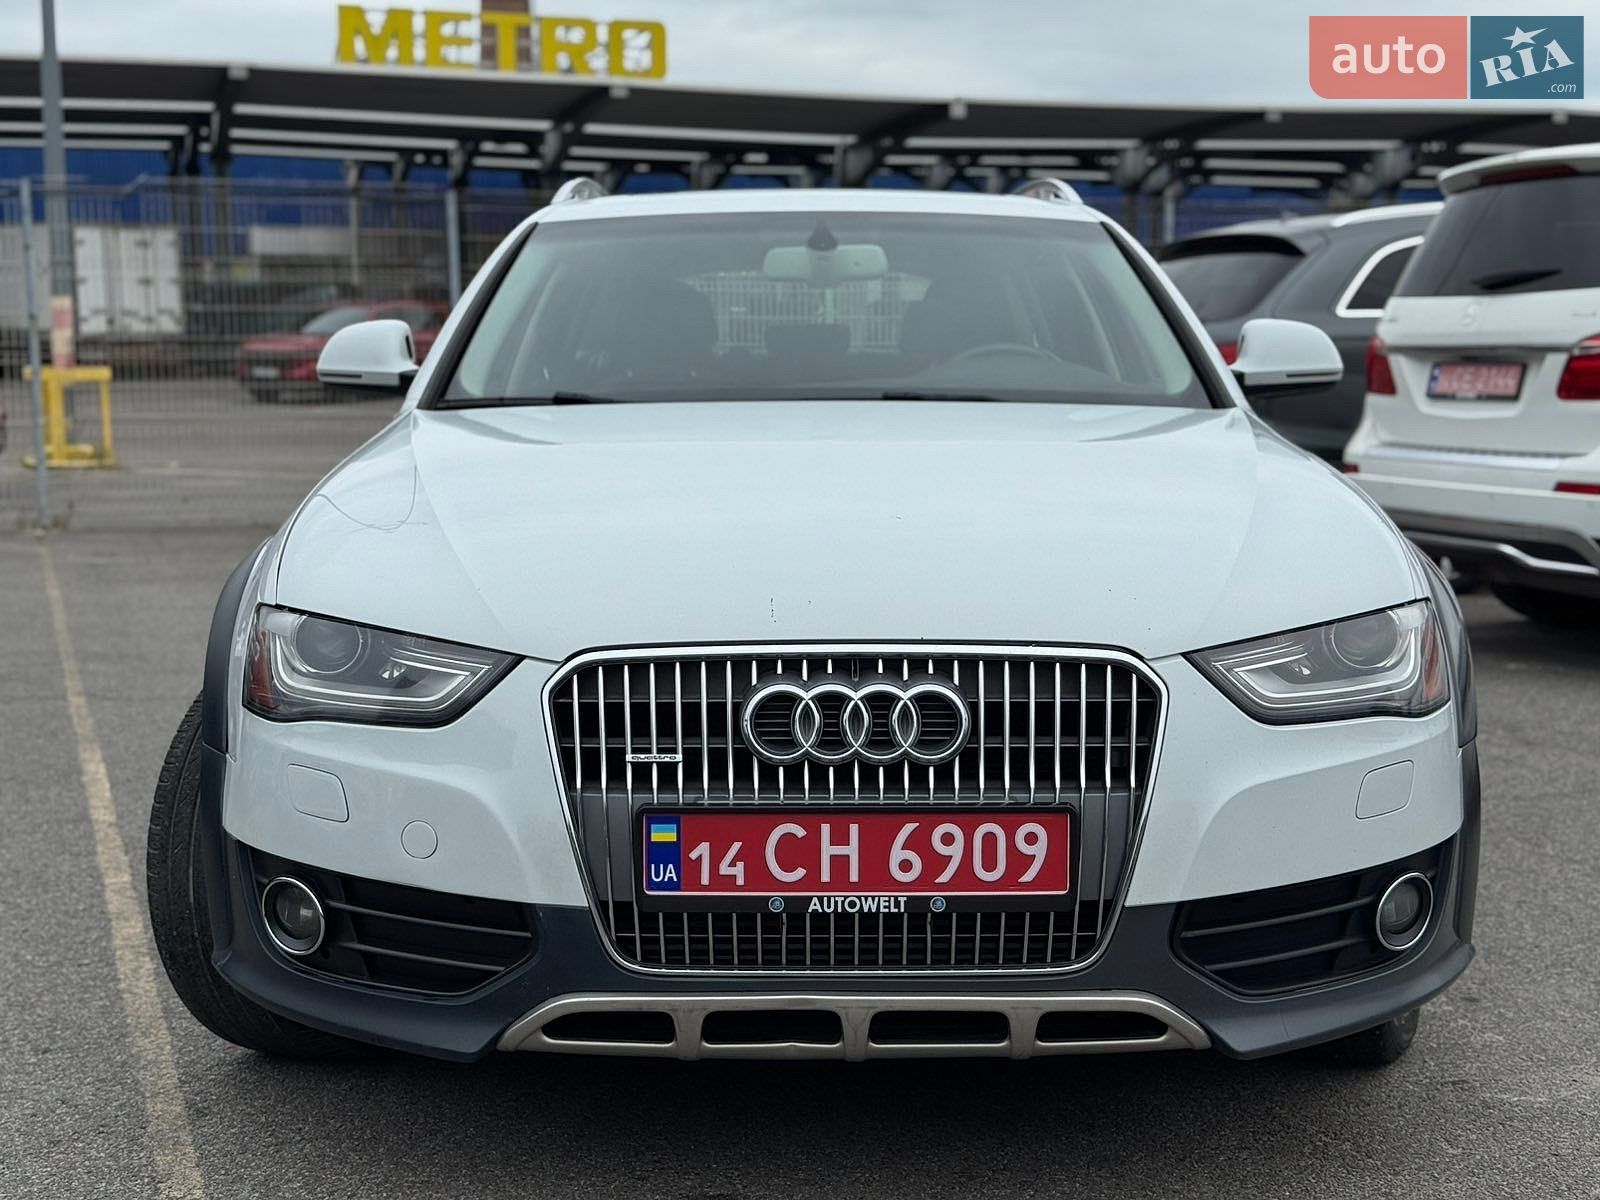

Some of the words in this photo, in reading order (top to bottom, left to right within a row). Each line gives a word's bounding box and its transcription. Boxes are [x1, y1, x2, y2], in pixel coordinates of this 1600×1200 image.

[337, 5, 666, 79] METRO
[651, 863, 678, 882] UA
[688, 841, 745, 886] 14
[764, 822, 859, 883] CH
[888, 822, 1048, 883] 6909
[807, 896, 908, 914] AUTOWELT
